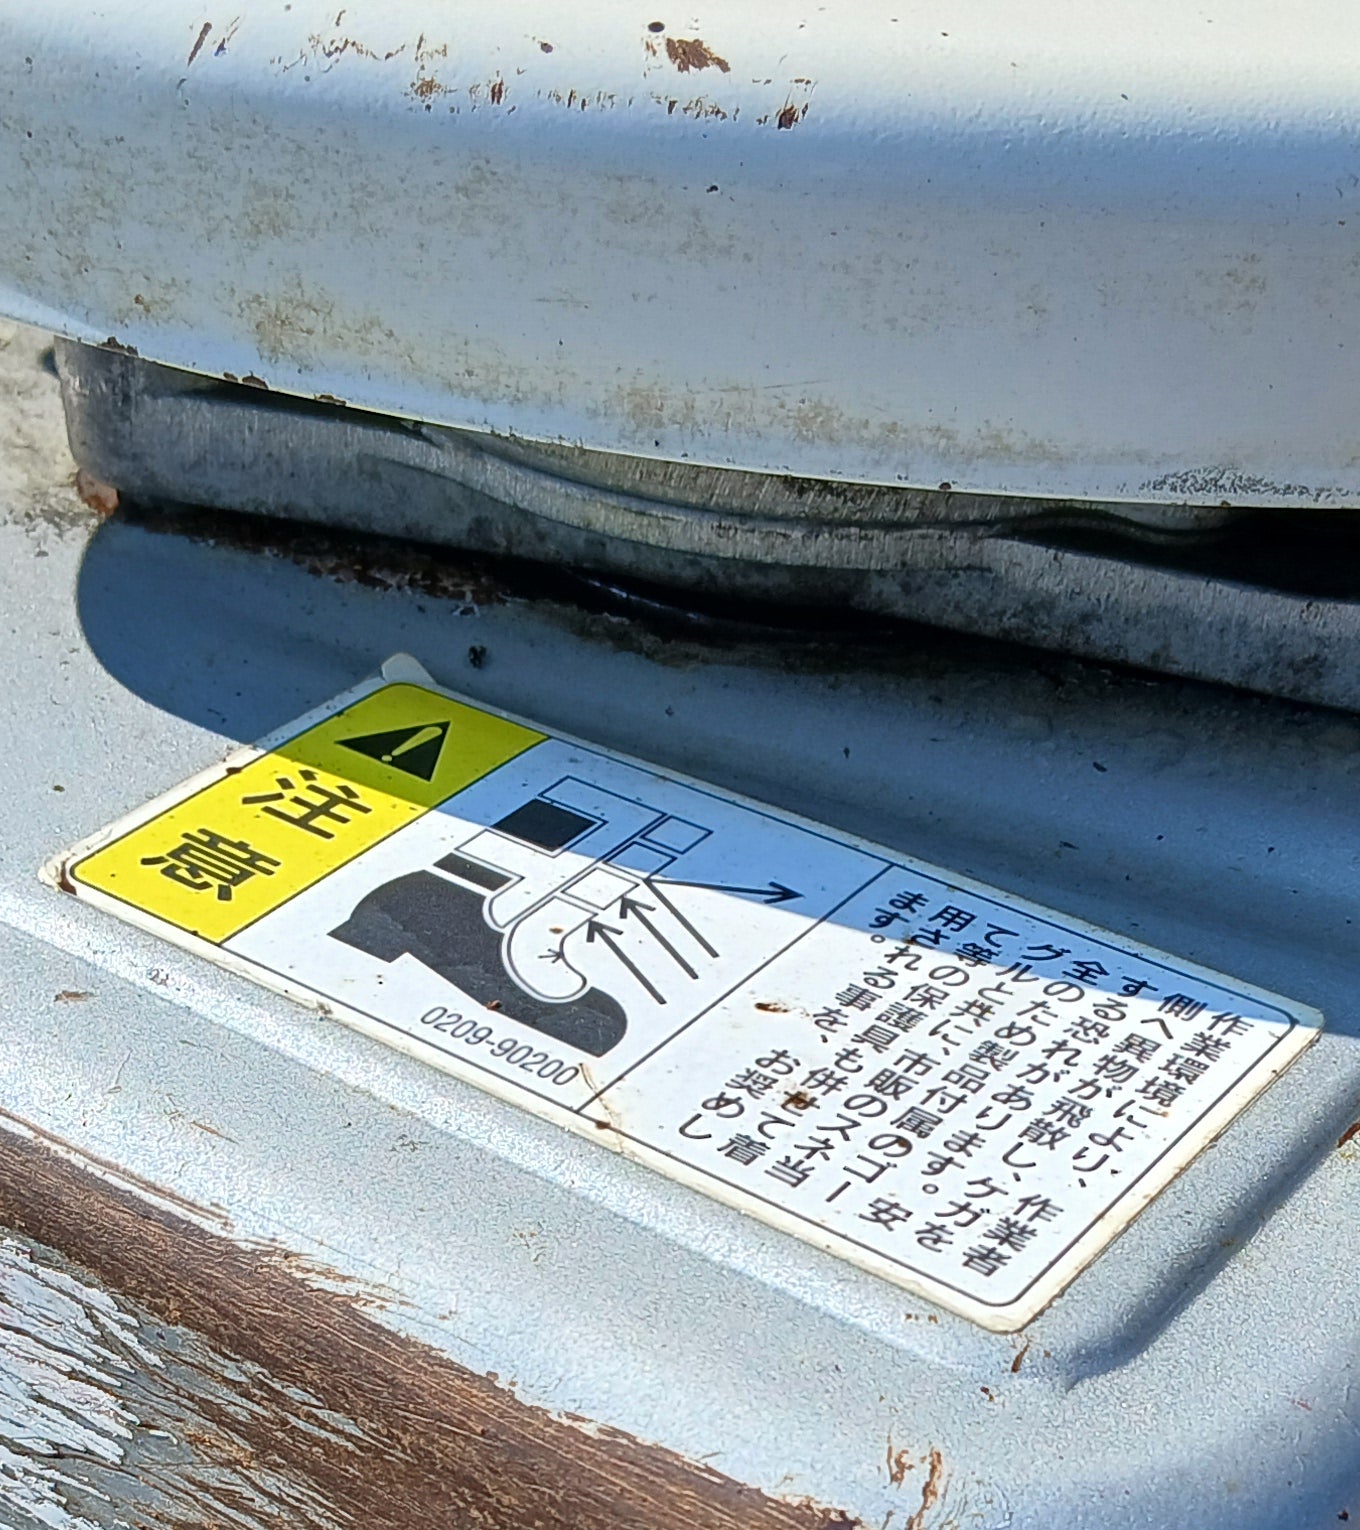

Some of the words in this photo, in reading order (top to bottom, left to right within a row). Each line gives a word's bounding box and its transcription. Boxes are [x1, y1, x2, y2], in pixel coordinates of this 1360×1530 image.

[140, 769, 373, 902] 注意
[868, 890, 930, 944] ます。
[420, 1006, 580, 1086] 0209-90200
